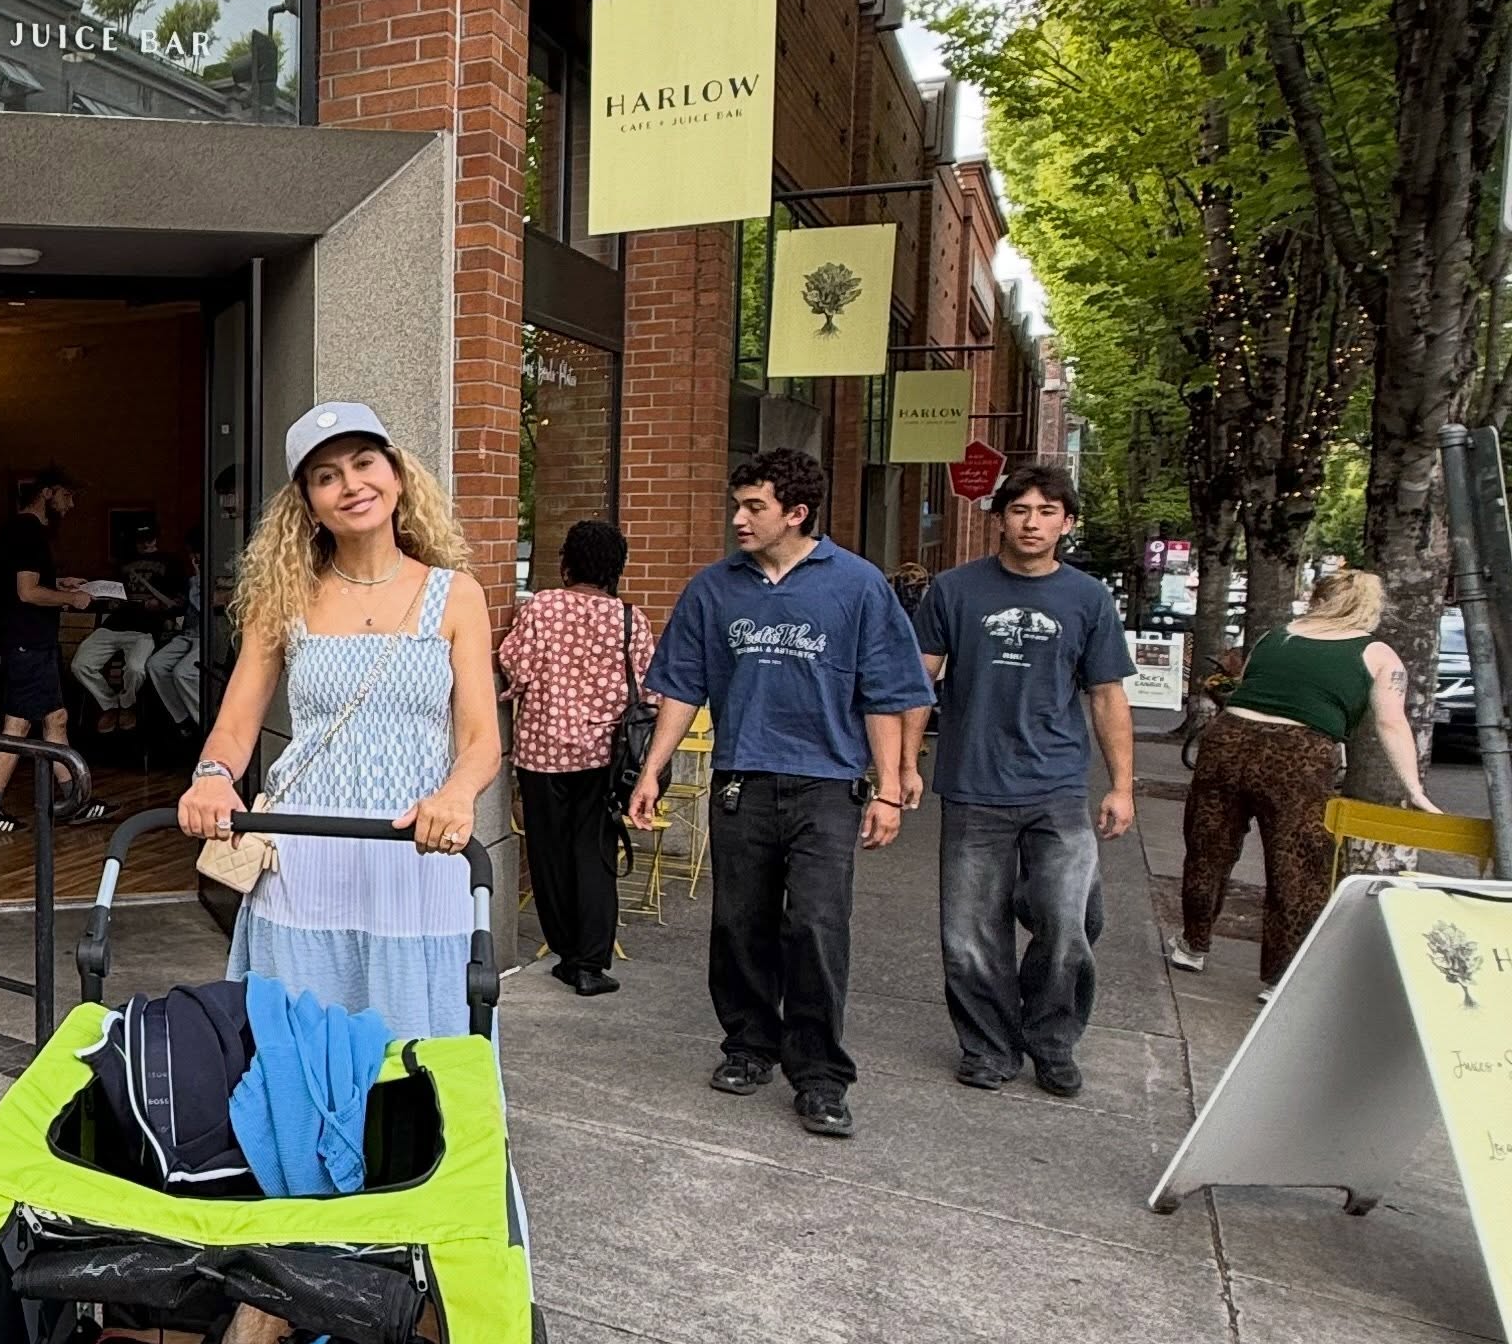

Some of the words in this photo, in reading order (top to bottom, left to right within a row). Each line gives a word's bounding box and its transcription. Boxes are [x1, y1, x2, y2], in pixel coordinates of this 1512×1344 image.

[9, 22, 118, 52] JUICE
[140, 28, 212, 56] BAR
[606, 74, 760, 117] HARLOW
[620, 121, 652, 134] CAFE
[672, 113, 710, 126] JUICE
[716, 108, 743, 120] BAR
[898, 408, 965, 418] HARLOW
